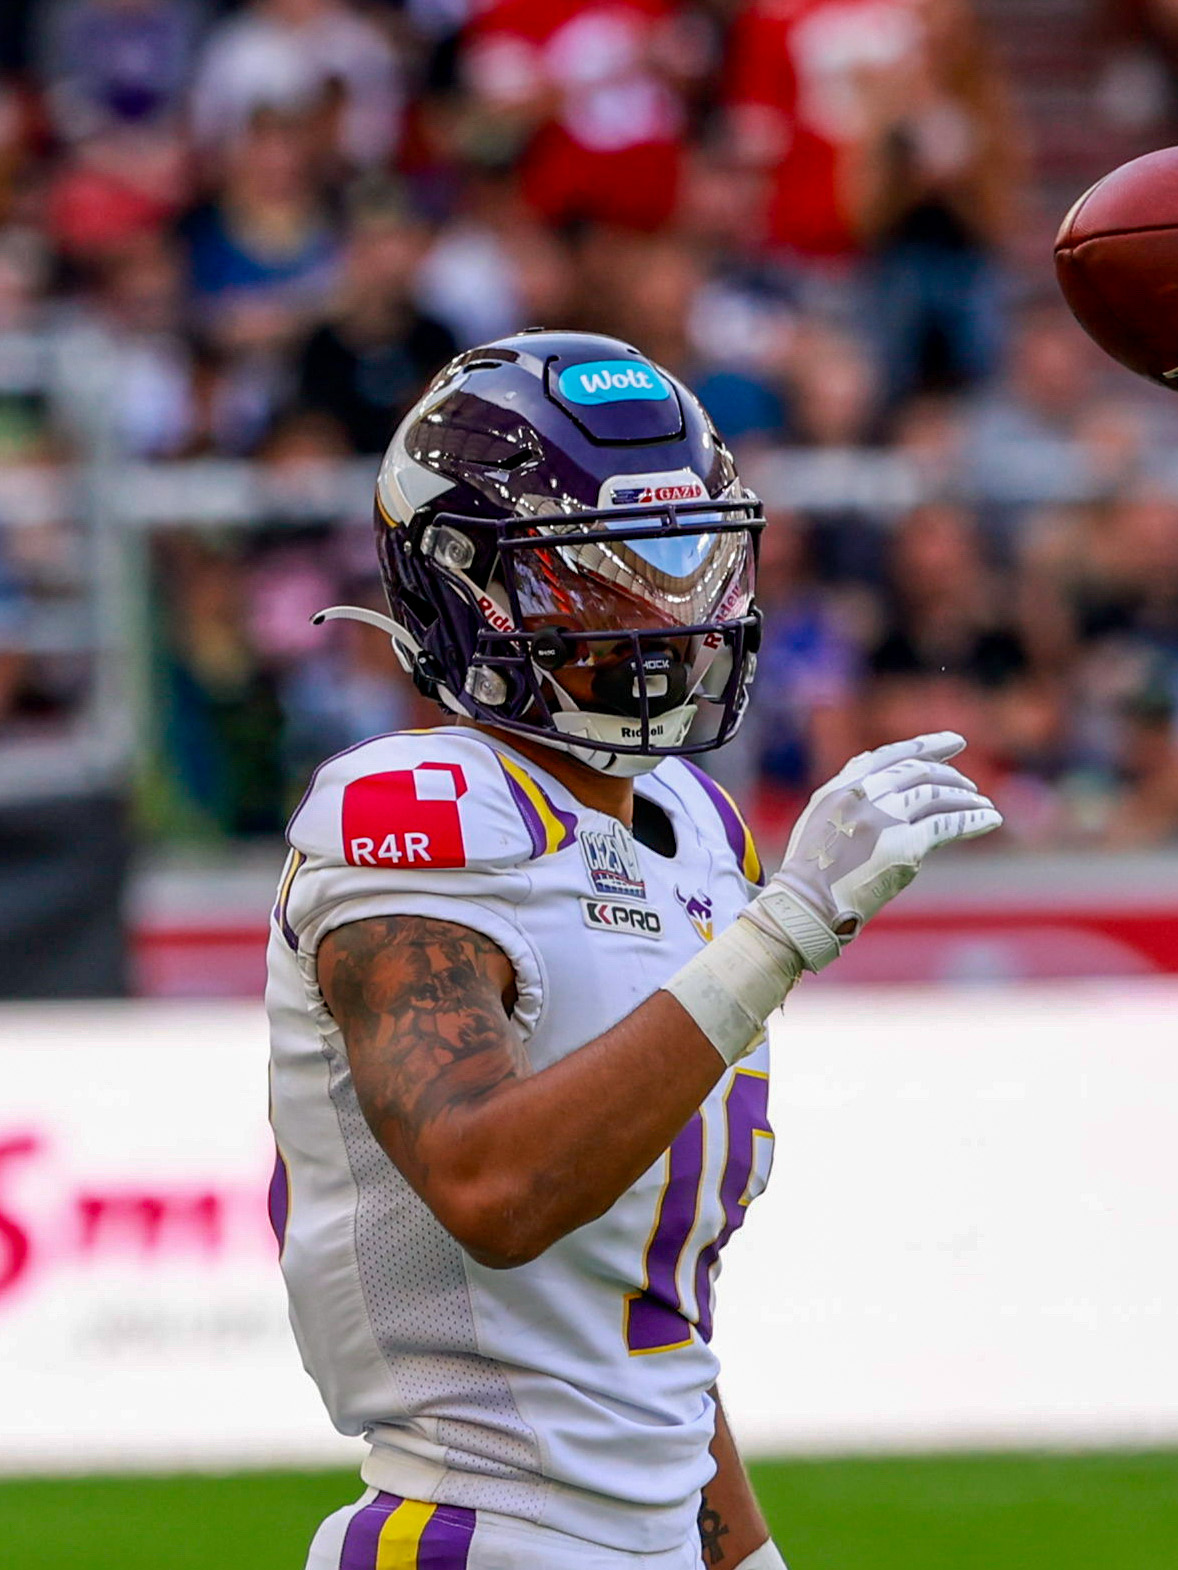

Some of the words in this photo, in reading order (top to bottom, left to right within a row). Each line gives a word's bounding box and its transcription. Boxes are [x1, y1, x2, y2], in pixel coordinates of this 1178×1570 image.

[580, 369, 654, 393] Wolt
[621, 725, 664, 738] Ridell
[351, 832, 432, 866] R4R
